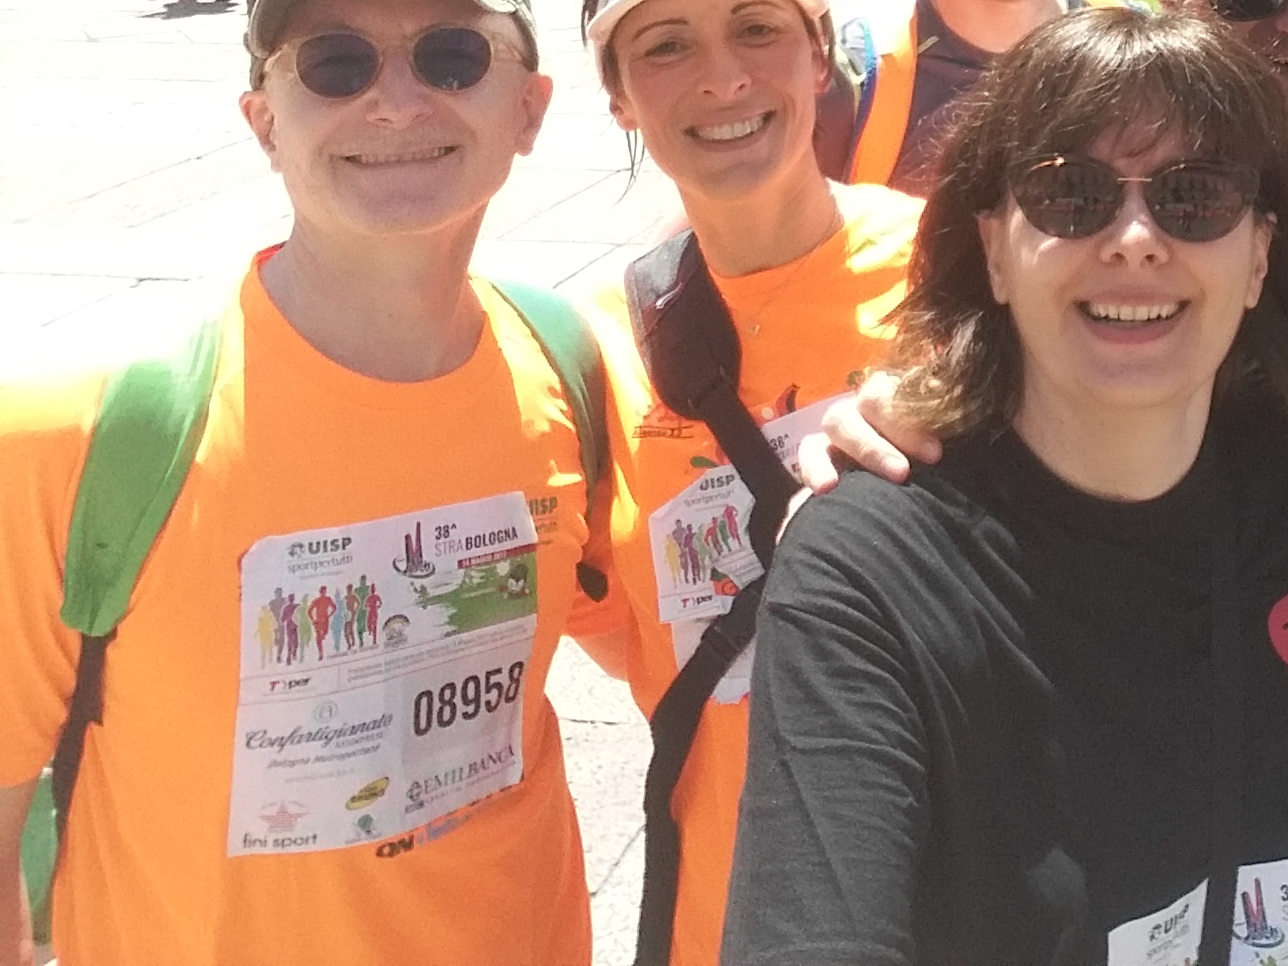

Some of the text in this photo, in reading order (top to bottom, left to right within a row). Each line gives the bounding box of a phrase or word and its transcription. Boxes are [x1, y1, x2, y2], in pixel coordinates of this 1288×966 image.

[308, 537, 352, 555] UISP
[414, 661, 524, 737] 08958
[245, 713, 393, 754] Confartigianato
[242, 833, 317, 849] fini sport
